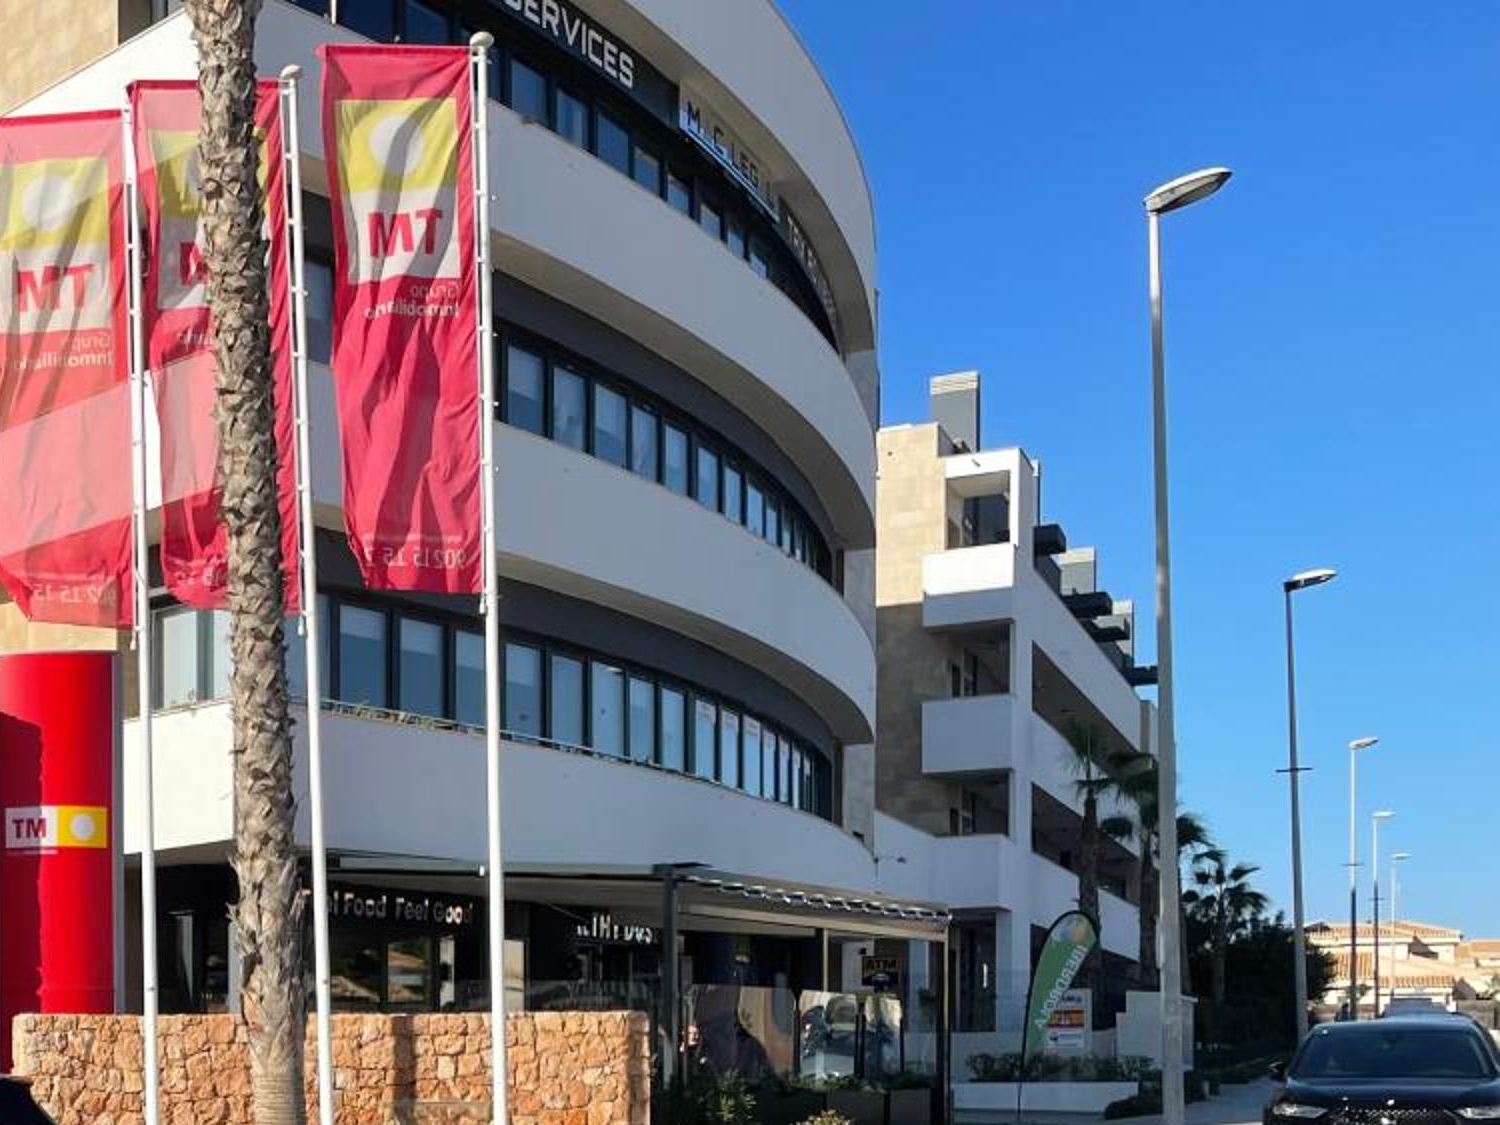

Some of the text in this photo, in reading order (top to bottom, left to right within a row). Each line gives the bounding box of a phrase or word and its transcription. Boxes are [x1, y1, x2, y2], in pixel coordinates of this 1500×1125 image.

[11, 817, 47, 839] TM
[343, 892, 387, 918] Food
[395, 897, 428, 921] Feel
[866, 959, 898, 969] ATM
